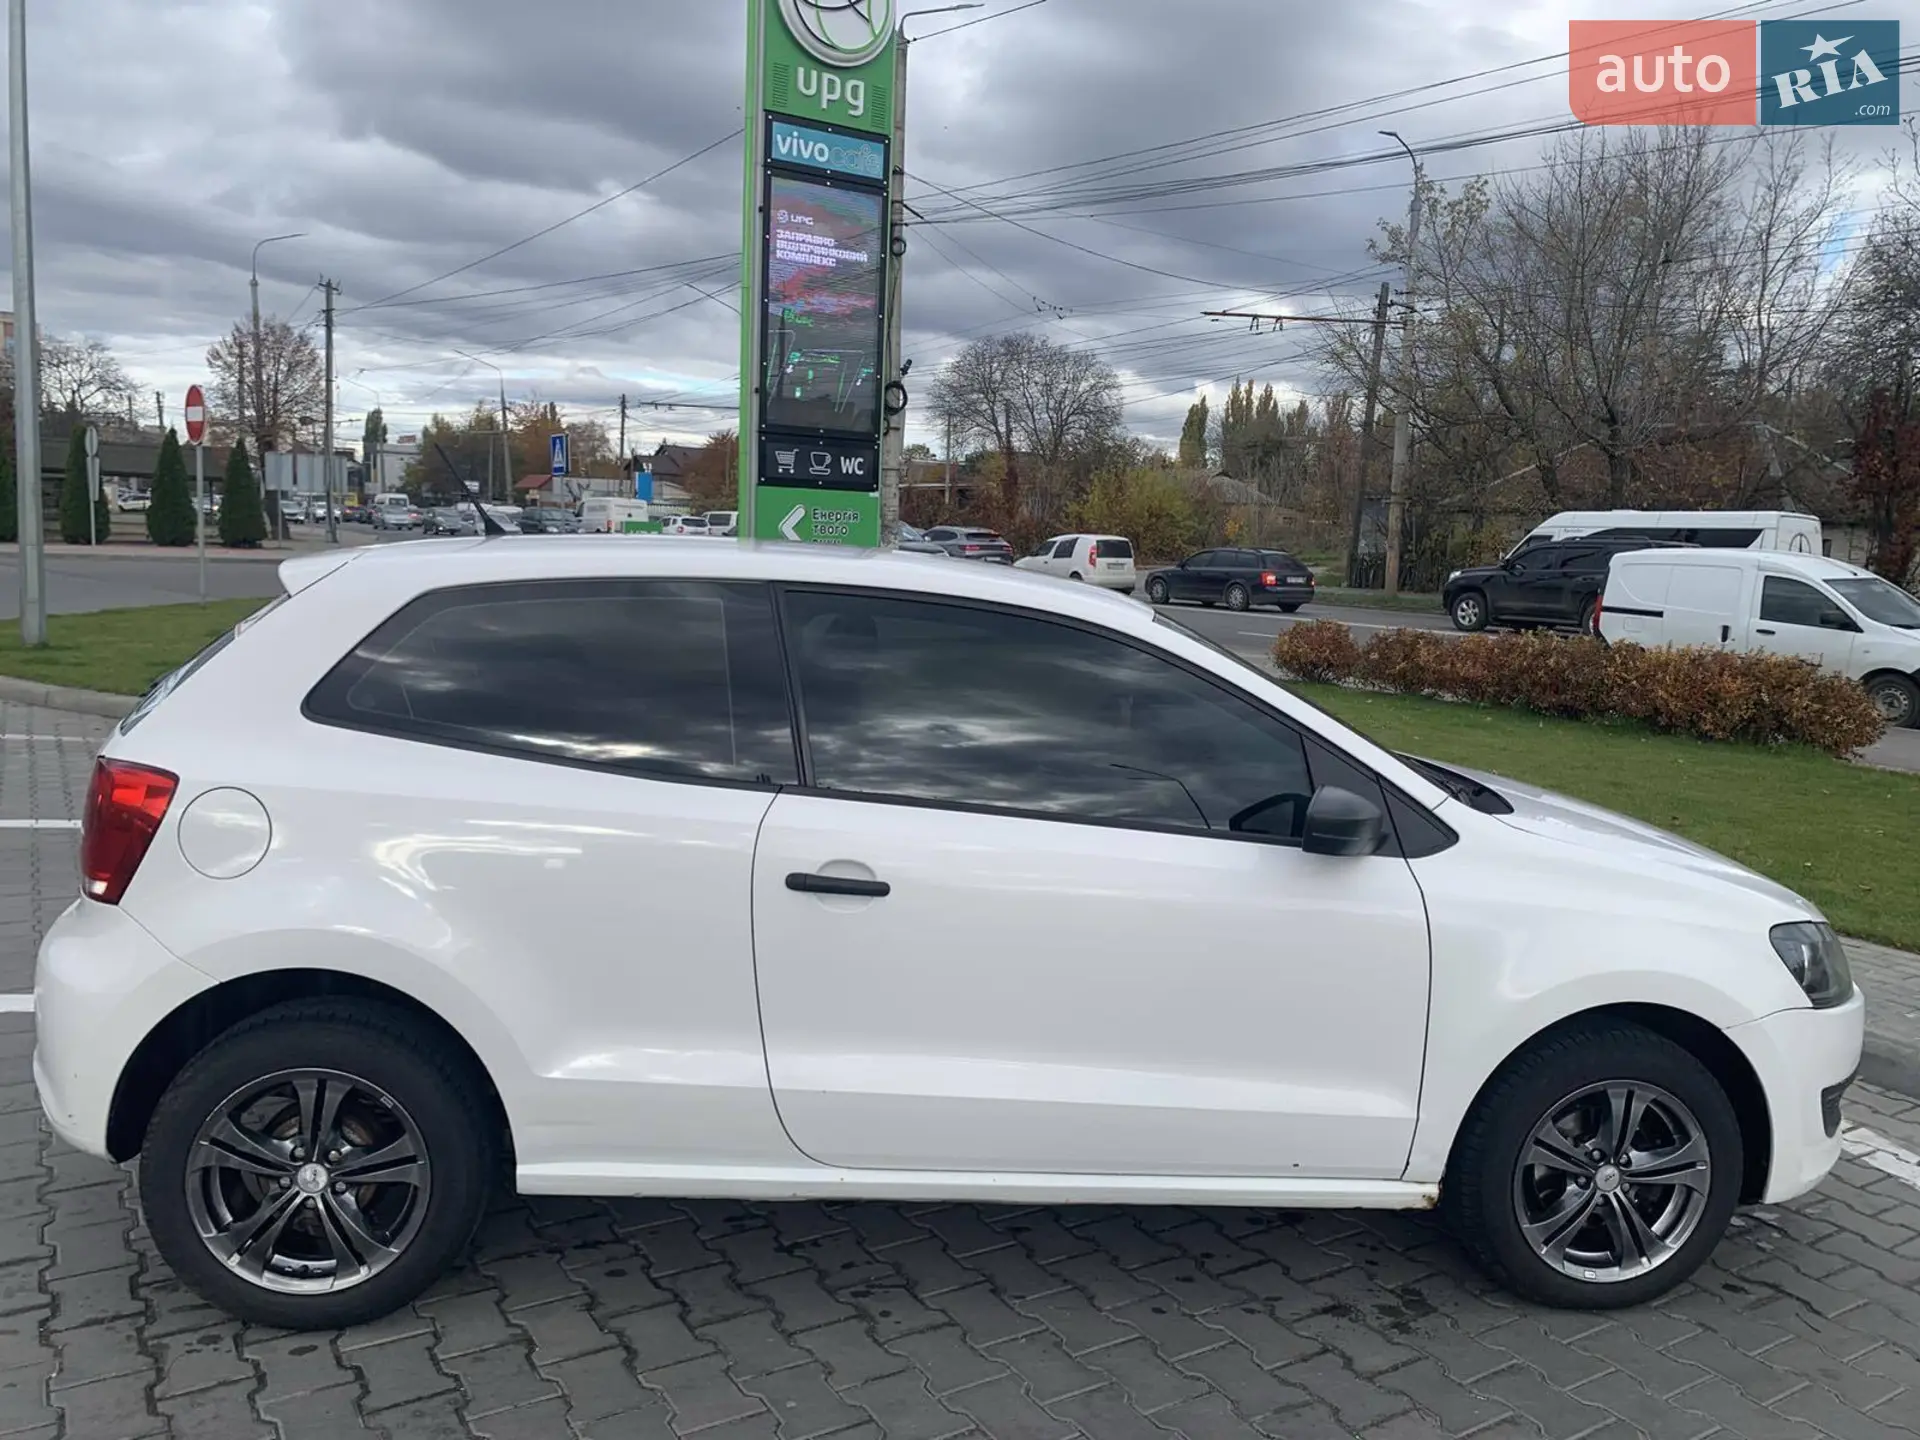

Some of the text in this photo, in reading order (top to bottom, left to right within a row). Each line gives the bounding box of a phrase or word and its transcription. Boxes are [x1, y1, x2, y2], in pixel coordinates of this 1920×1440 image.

[797, 66, 865, 116] upg
[840, 456, 864, 475] WC
[812, 508, 859, 522] Енергія
